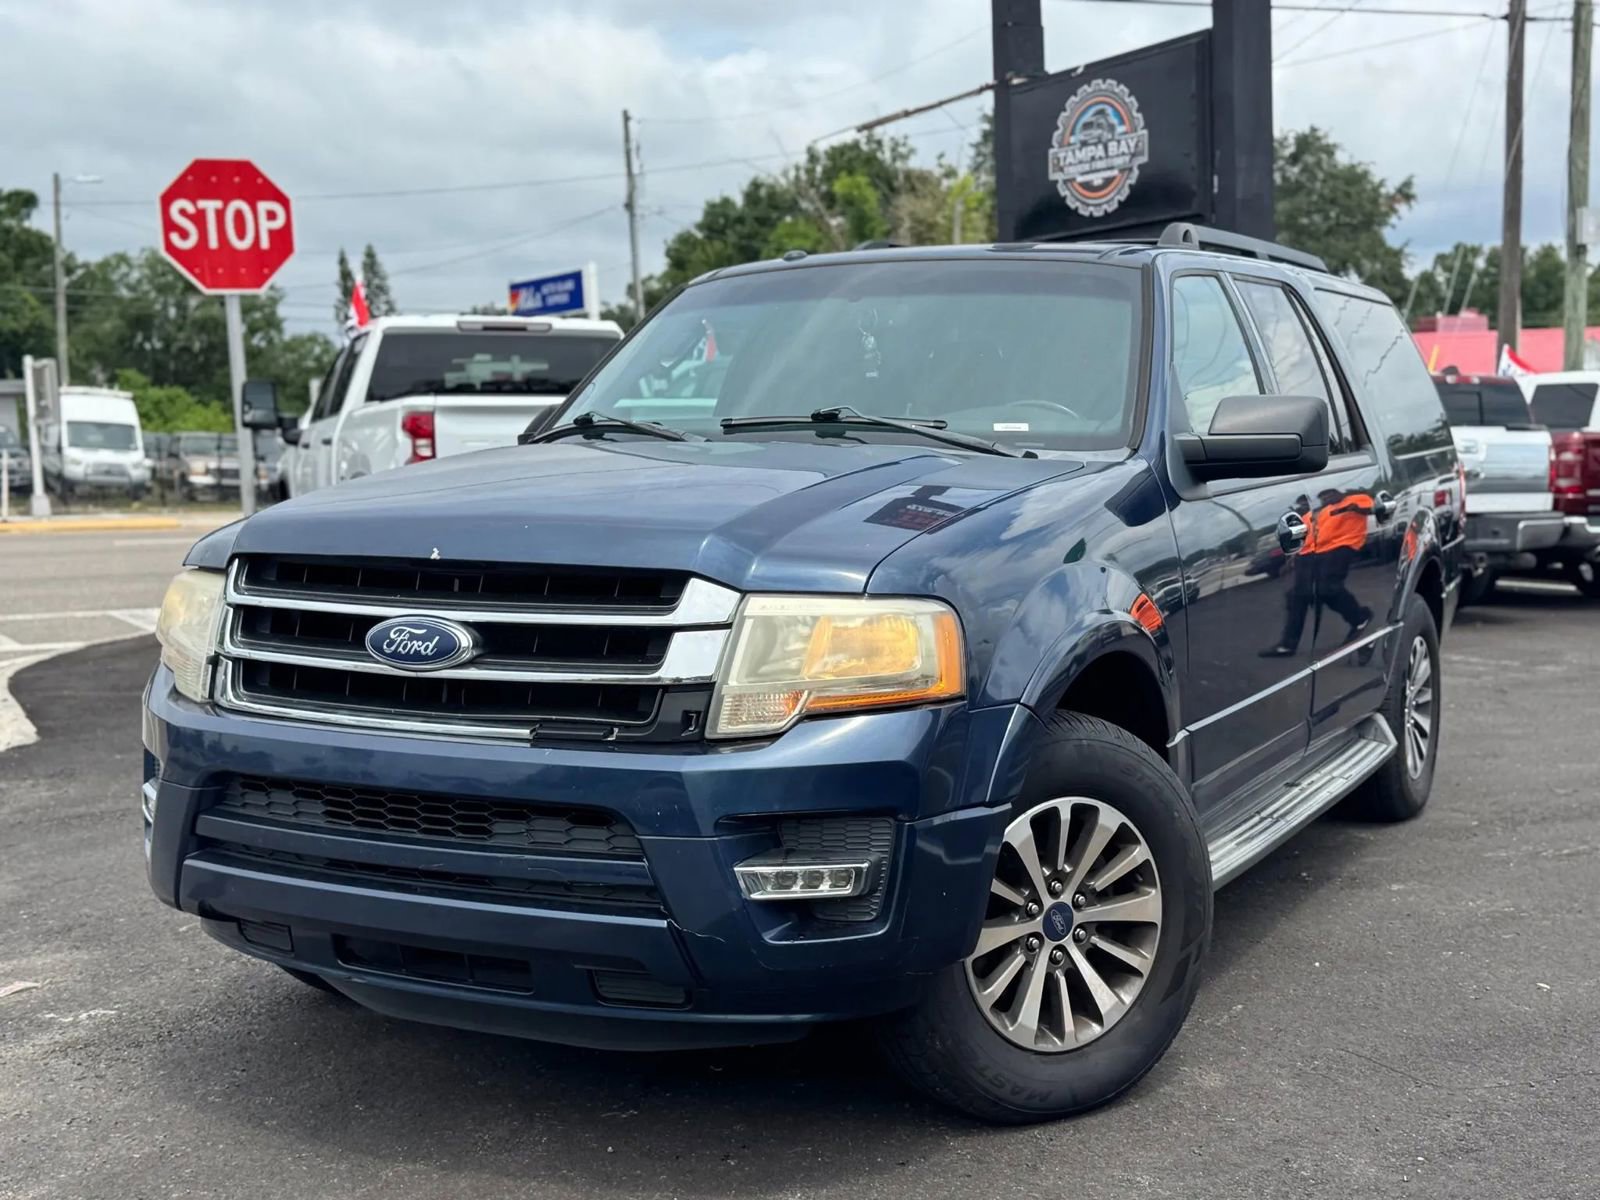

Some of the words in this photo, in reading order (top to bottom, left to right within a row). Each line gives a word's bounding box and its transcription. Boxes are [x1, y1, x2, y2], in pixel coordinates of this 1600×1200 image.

[1058, 144, 1106, 166] TAMPA
[1107, 138, 1137, 155] BAY
[168, 198, 287, 251] STOP
[383, 626, 440, 656] Ford
